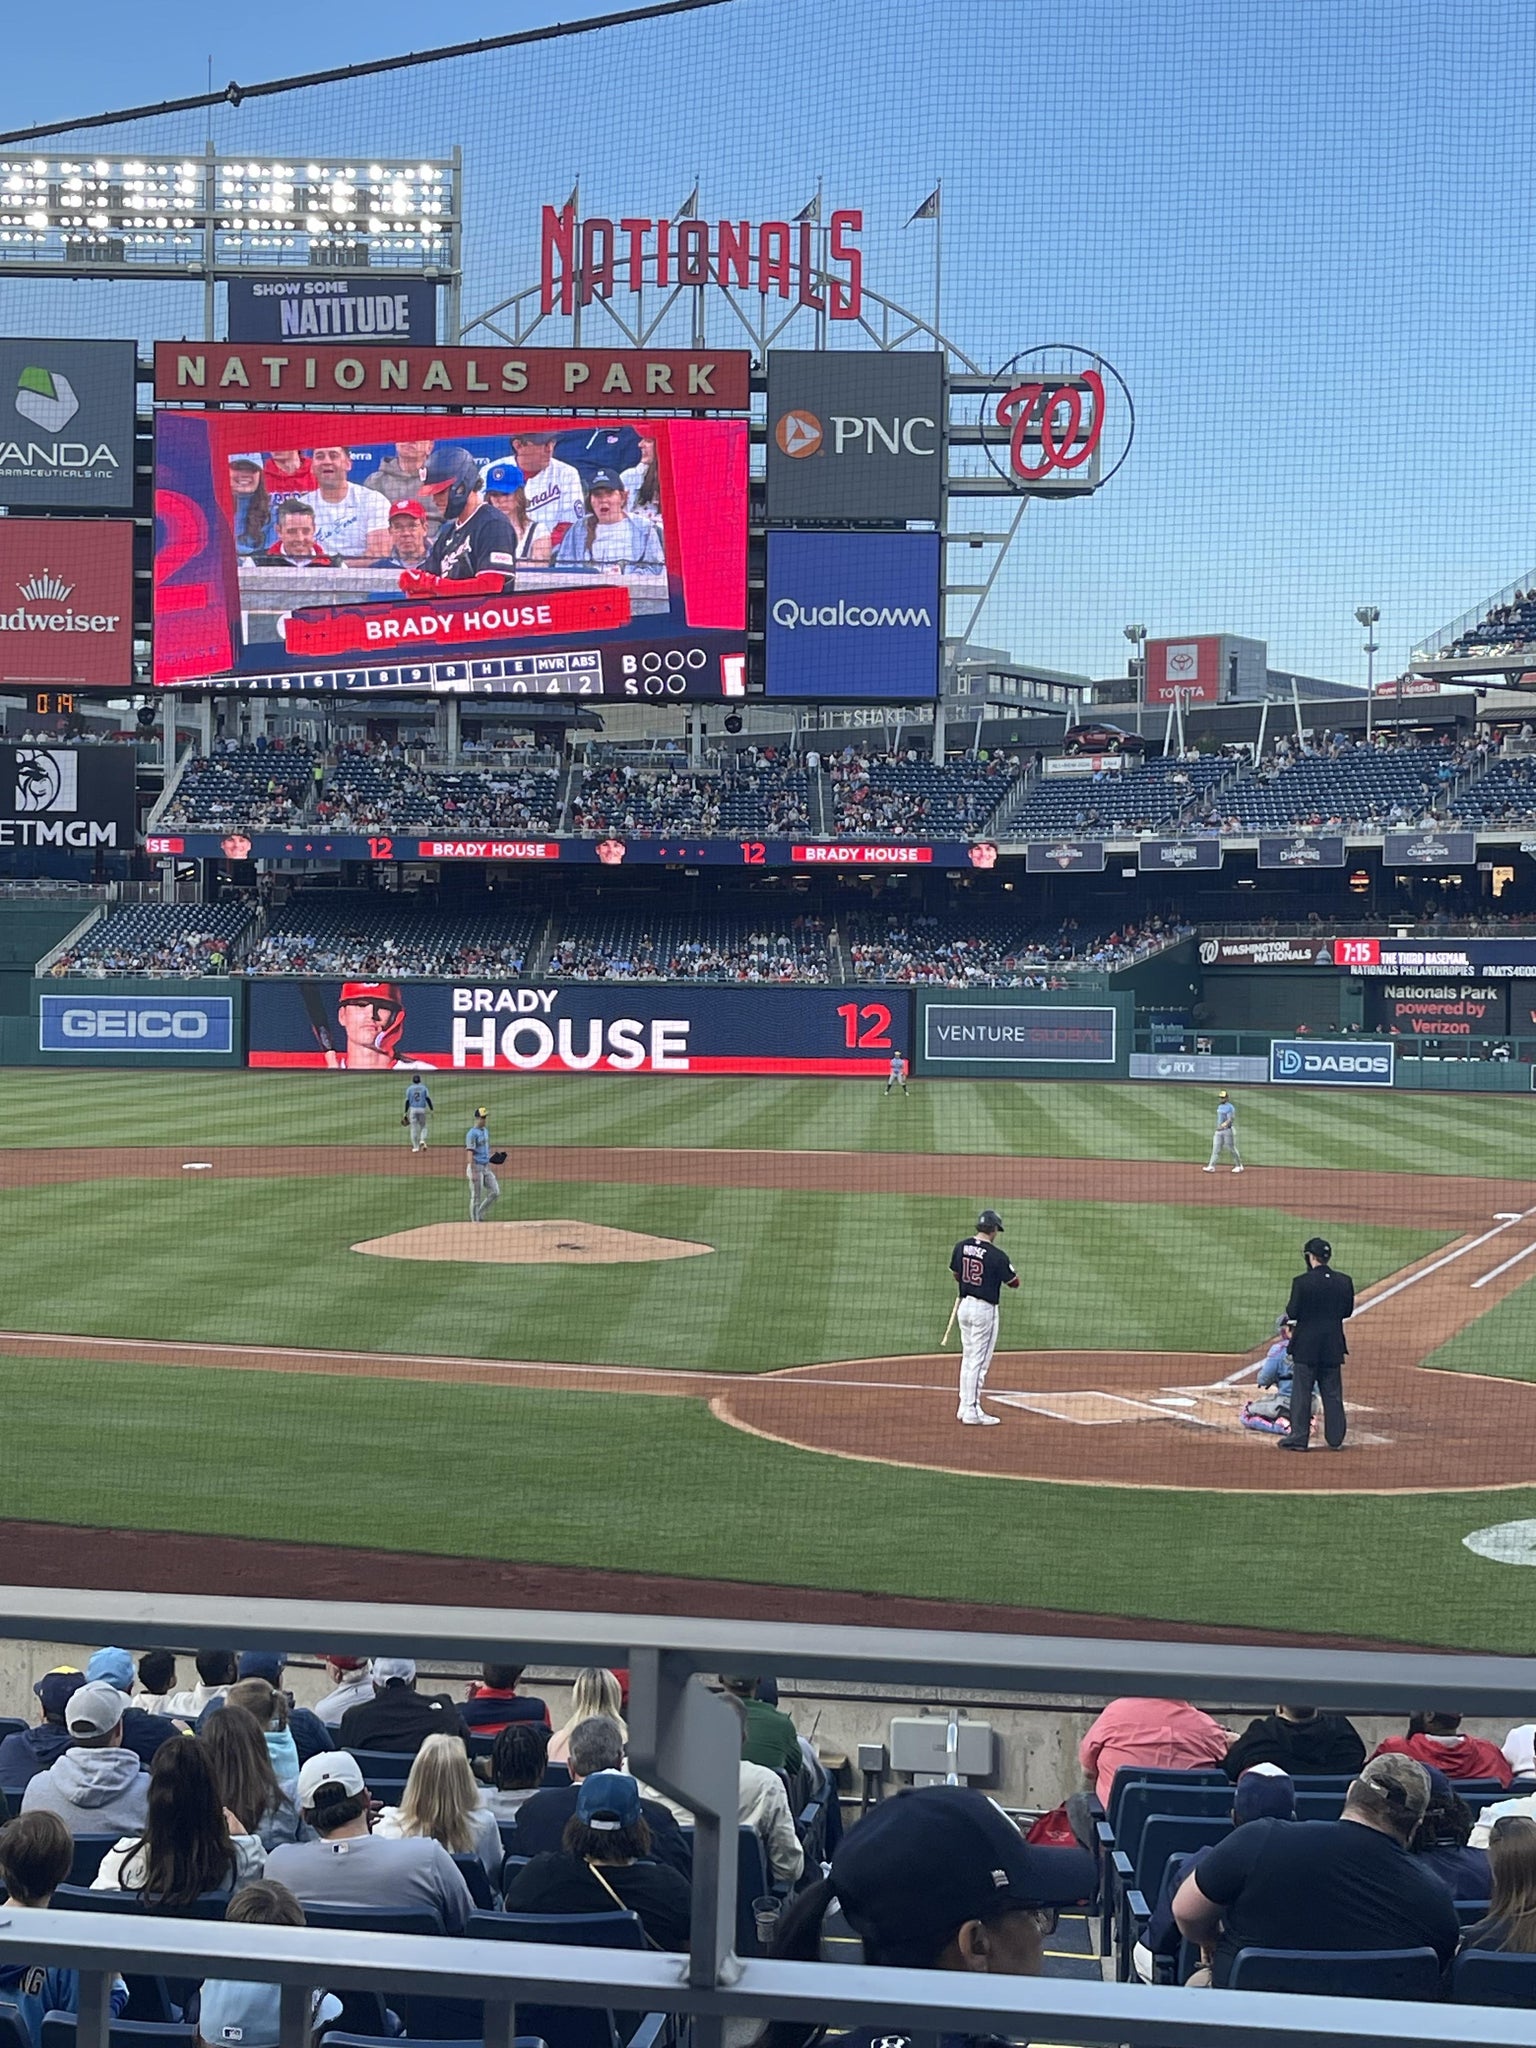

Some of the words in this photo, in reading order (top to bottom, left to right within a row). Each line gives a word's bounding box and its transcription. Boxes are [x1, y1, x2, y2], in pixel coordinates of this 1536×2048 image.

[541, 205, 862, 320] NATIONALS
[253, 283, 300, 296] SHOW
[304, 281, 348, 294] SOME
[281, 295, 409, 335] NATITUDE
[177, 355, 528, 393] NATIONALS
[564, 361, 716, 395] PARK
[830, 417, 935, 455] PNC
[366, 614, 453, 640] BRADY
[463, 605, 552, 631] HOUSE
[773, 599, 932, 629] Qualcomm
[281, 679, 291, 689] 5
[313, 676, 323, 687] 6
[347, 674, 356, 685] 7
[379, 671, 389, 682] 8
[412, 669, 421, 680] 9
[446, 666, 455, 677] R
[482, 664, 491, 674] H
[515, 661, 523, 672] E
[538, 659, 565, 671] MVR
[572, 655, 596, 668] ABS
[623, 656, 637, 673] B
[580, 676, 591, 687] 2
[625, 678, 637, 694] S
[368, 837, 393, 859] 12
[433, 843, 486, 856] BRADY
[492, 844, 545, 857] HOUSE
[740, 842, 766, 863] 12
[806, 848, 859, 861] BRADY
[865, 847, 918, 861] HOUSE
[1407, 848, 1448, 857] CHAMPIONS
[1222, 941, 1289, 956] WASHINGTON
[1254, 949, 1311, 963] NATIONALS
[1343, 943, 1370, 962] 7:15
[1381, 952, 1397, 964] THE
[1399, 952, 1424, 964] THIRD
[1351, 966, 1398, 976] NATIONALS
[1400, 966, 1475, 976] PHILANTHROPIES
[453, 988, 558, 1012] BRADY
[1384, 985, 1457, 999] Nationals
[1460, 985, 1498, 1000] Park
[1395, 1001, 1464, 1017] powered
[1466, 1001, 1486, 1018] by
[62, 1009, 208, 1039] GEICO
[837, 1003, 893, 1048] 12
[1411, 1019, 1470, 1034] Verizon
[453, 1017, 690, 1069] HOUSE
[937, 1025, 1025, 1042] VENTURE
[1029, 1027, 1104, 1043] GLOBAL
[1173, 1062, 1196, 1072] RTX
[1304, 1055, 1389, 1073] DABOS
[962, 1257, 984, 1286] 12
